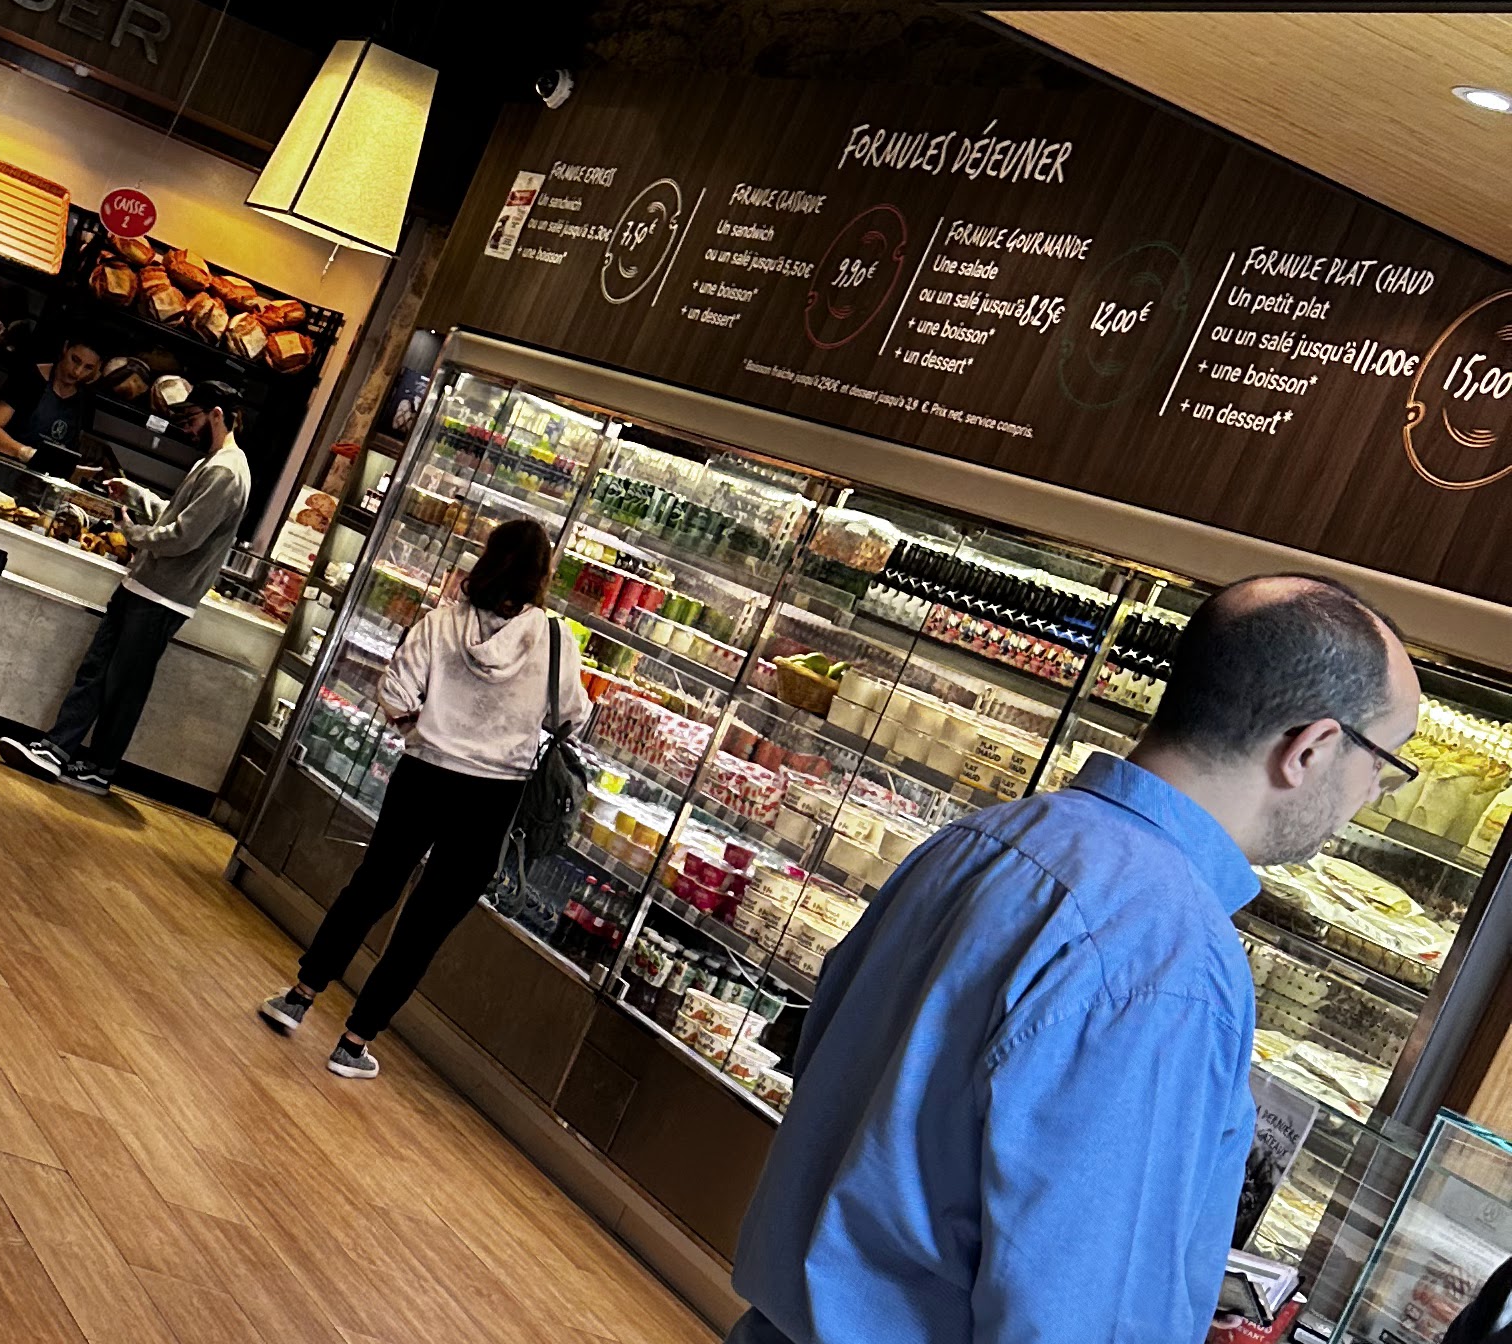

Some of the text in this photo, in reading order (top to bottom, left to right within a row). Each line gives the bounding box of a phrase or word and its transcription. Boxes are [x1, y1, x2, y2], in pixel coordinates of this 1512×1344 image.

[837, 118, 1073, 183] FORMULES DÉJEUNER
[548, 160, 618, 188] FORMULE EXPRESS
[113, 196, 148, 216] CAISSE
[537, 192, 582, 211] Un sandwich
[728, 183, 828, 214] FORMULE CLASSIQUE
[121, 216, 130, 228] 2
[528, 218, 538, 229] ou
[537, 220, 548, 231] un
[716, 219, 775, 242] Un sandwich
[521, 247, 537, 259] une
[945, 220, 1093, 260] FORMULE GOURMANDE
[704, 248, 718, 261] ou
[717, 251, 731, 263] un
[730, 250, 752, 267] salé
[782, 259, 815, 279] 5,50€
[831, 258, 880, 288] 9,90€
[933, 254, 999, 280] Une salade
[1242, 246, 1435, 296] FORMULE PLAT CHAUD
[692, 280, 699, 290] +
[698, 281, 717, 295] une
[919, 287, 936, 302] ou
[936, 290, 953, 305] un
[954, 290, 983, 310] salé
[680, 305, 688, 315] +
[687, 307, 701, 320] un
[1227, 286, 1331, 320] Un petit plat
[908, 317, 915, 329] +
[916, 318, 940, 337] une
[1090, 301, 1154, 336] 12,00€
[894, 347, 902, 359] +
[903, 348, 919, 365] un
[1211, 325, 1234, 342] ou
[1235, 329, 1256, 348] un
[1259, 330, 1295, 353] salé
[1353, 339, 1420, 377] 11,00€
[1197, 360, 1208, 374] +
[1211, 363, 1242, 384] une
[1443, 353, 1512, 402] 15,00
[849, 384, 879, 401] dessert
[930, 402, 948, 418] Prix
[948, 409, 964, 423] net,
[965, 413, 997, 429] service
[996, 420, 1034, 439] compris.
[1180, 398, 1191, 413] +
[1192, 400, 1215, 422] un
[1261, 1109, 1300, 1145] DERNIÈRE
